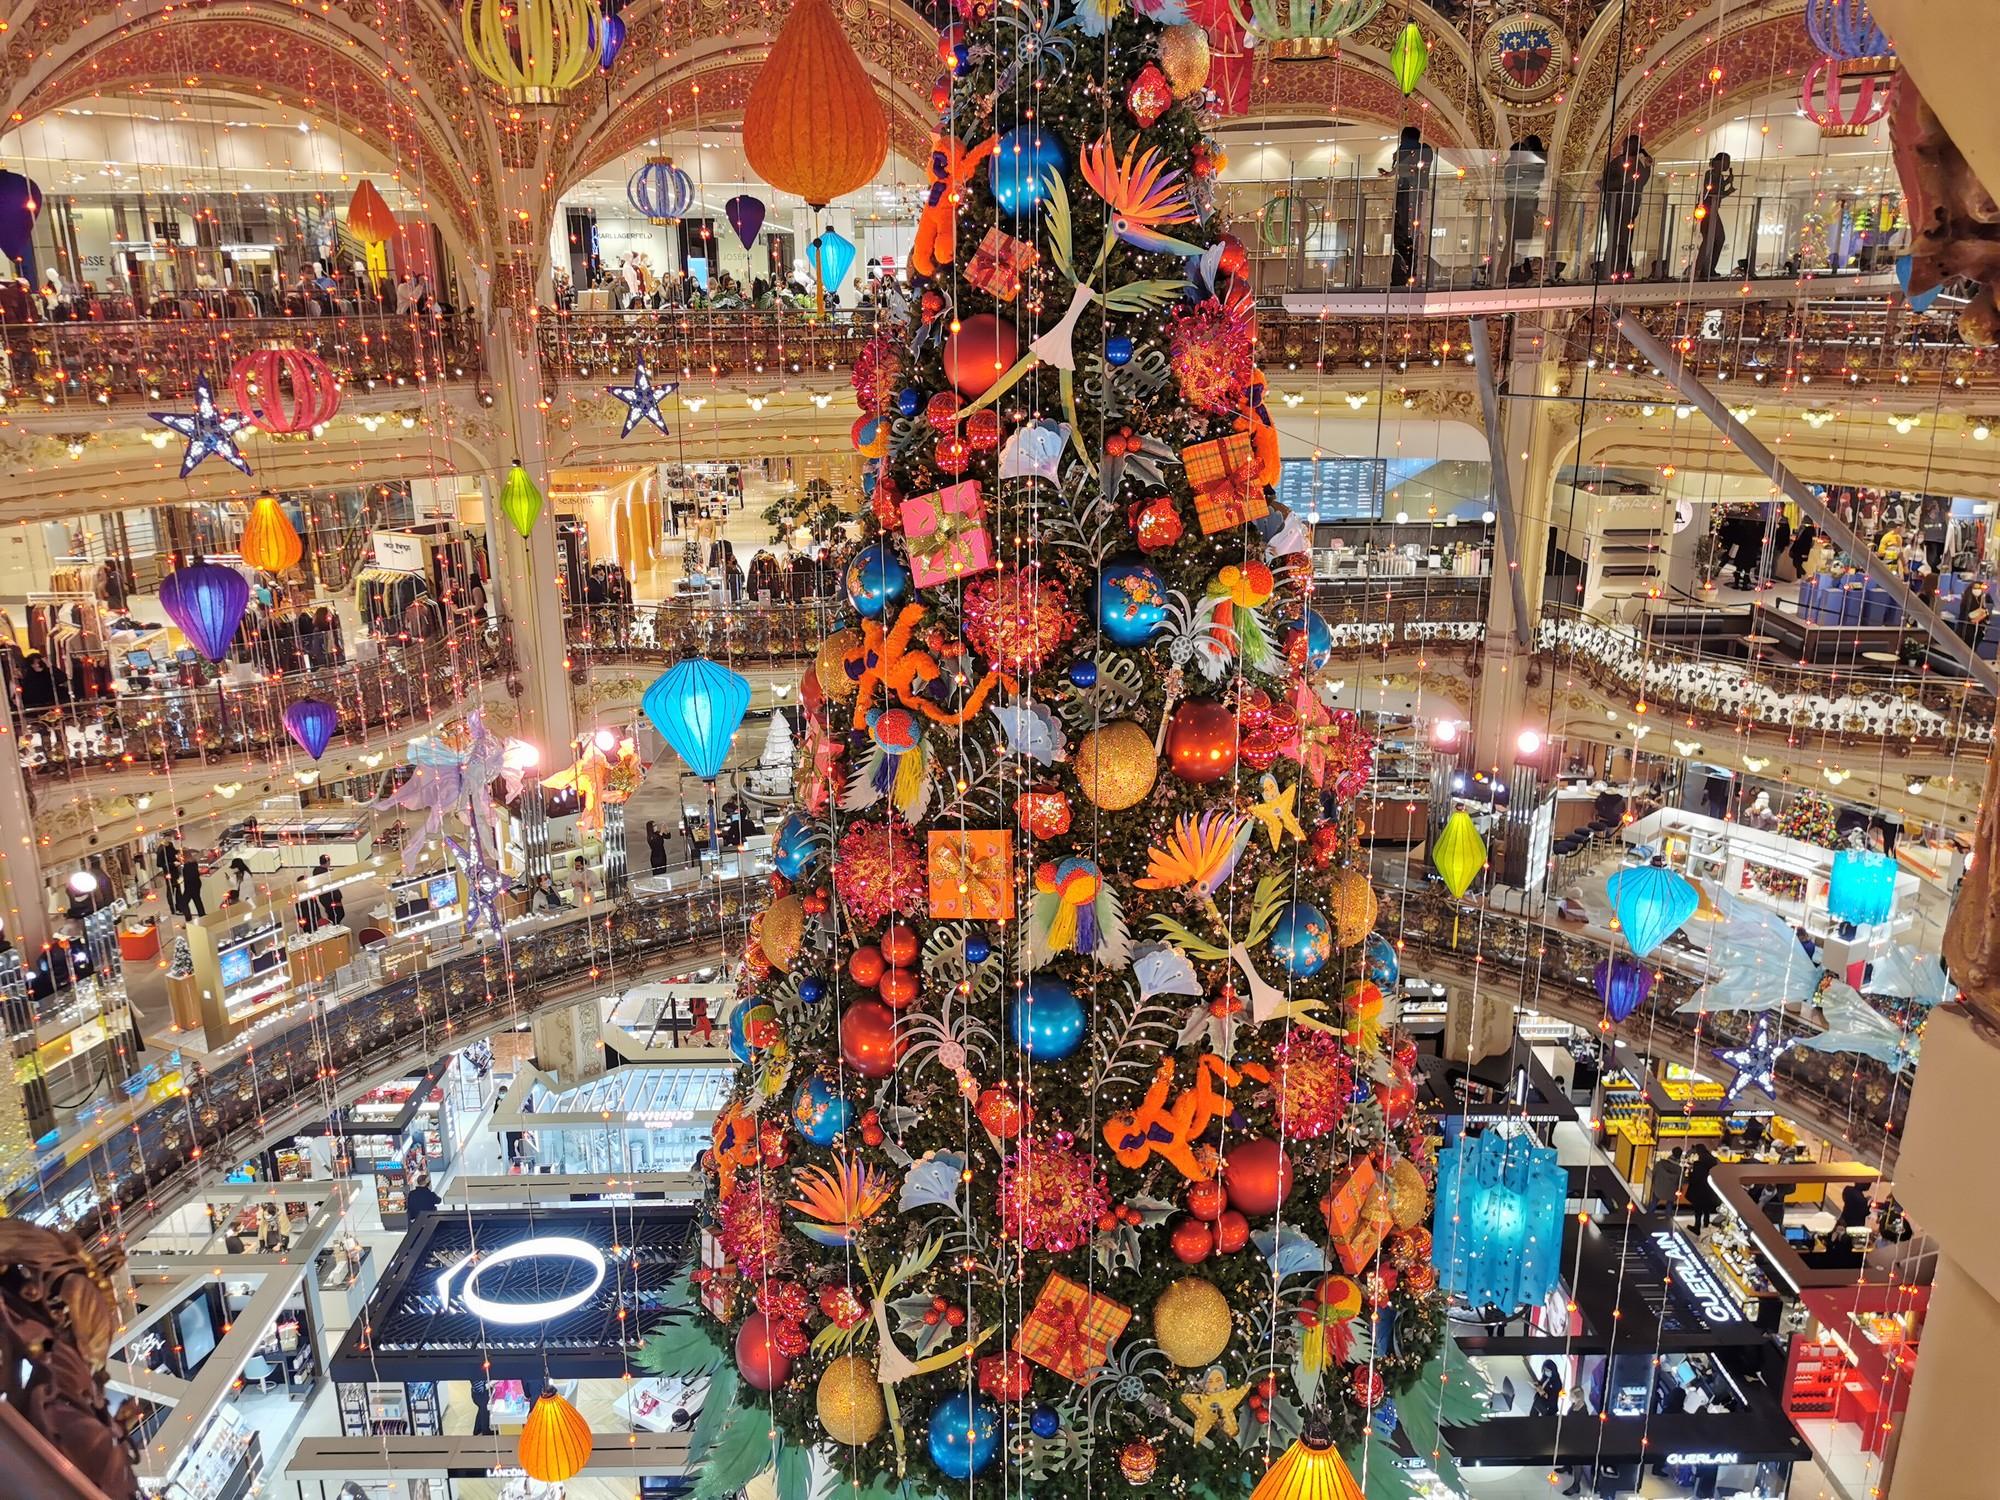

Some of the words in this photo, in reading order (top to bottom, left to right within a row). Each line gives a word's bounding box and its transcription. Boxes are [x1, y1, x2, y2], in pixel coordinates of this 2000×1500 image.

[723, 253, 753, 261] JOSEPH
[1651, 1231, 1730, 1322] GUERLAIN
[1666, 1453, 1738, 1464] GUERLAIN
[486, 1467, 528, 1478] LANCÔM
